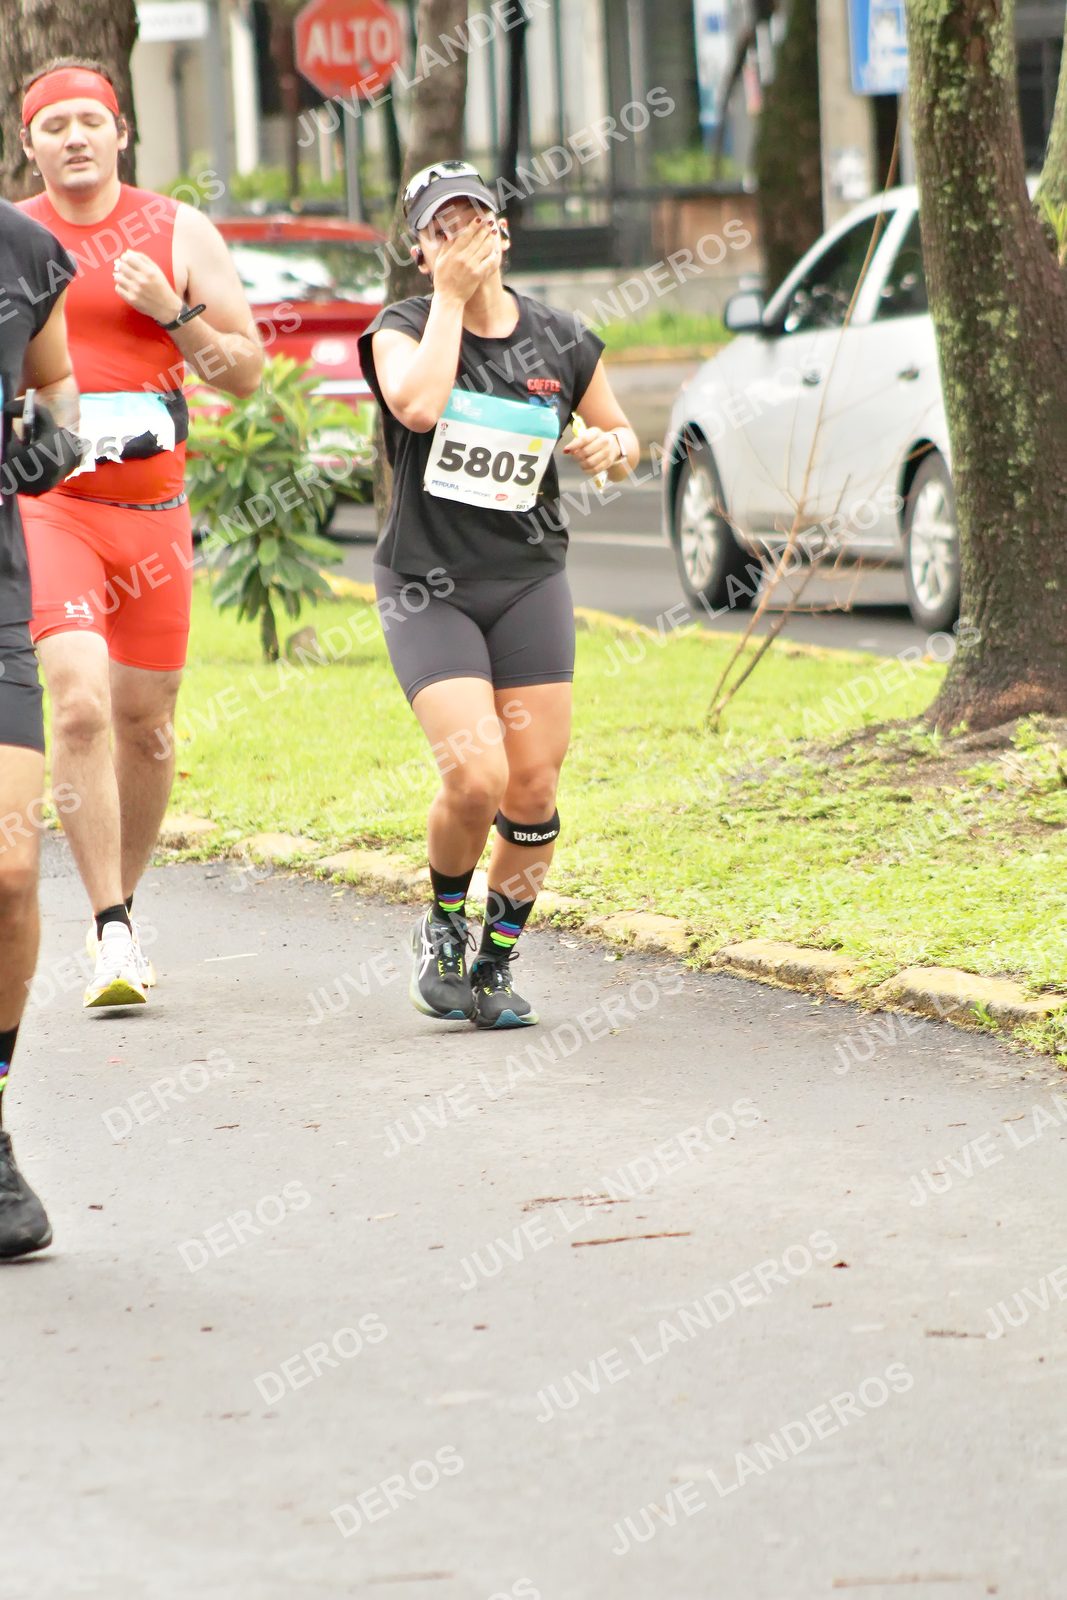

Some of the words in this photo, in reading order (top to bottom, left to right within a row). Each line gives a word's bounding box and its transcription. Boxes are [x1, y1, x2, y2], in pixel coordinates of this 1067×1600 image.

[303, 18, 394, 66] ALTO
[436, 440, 539, 486] 5803
[512, 829, 558, 842] Wilson
